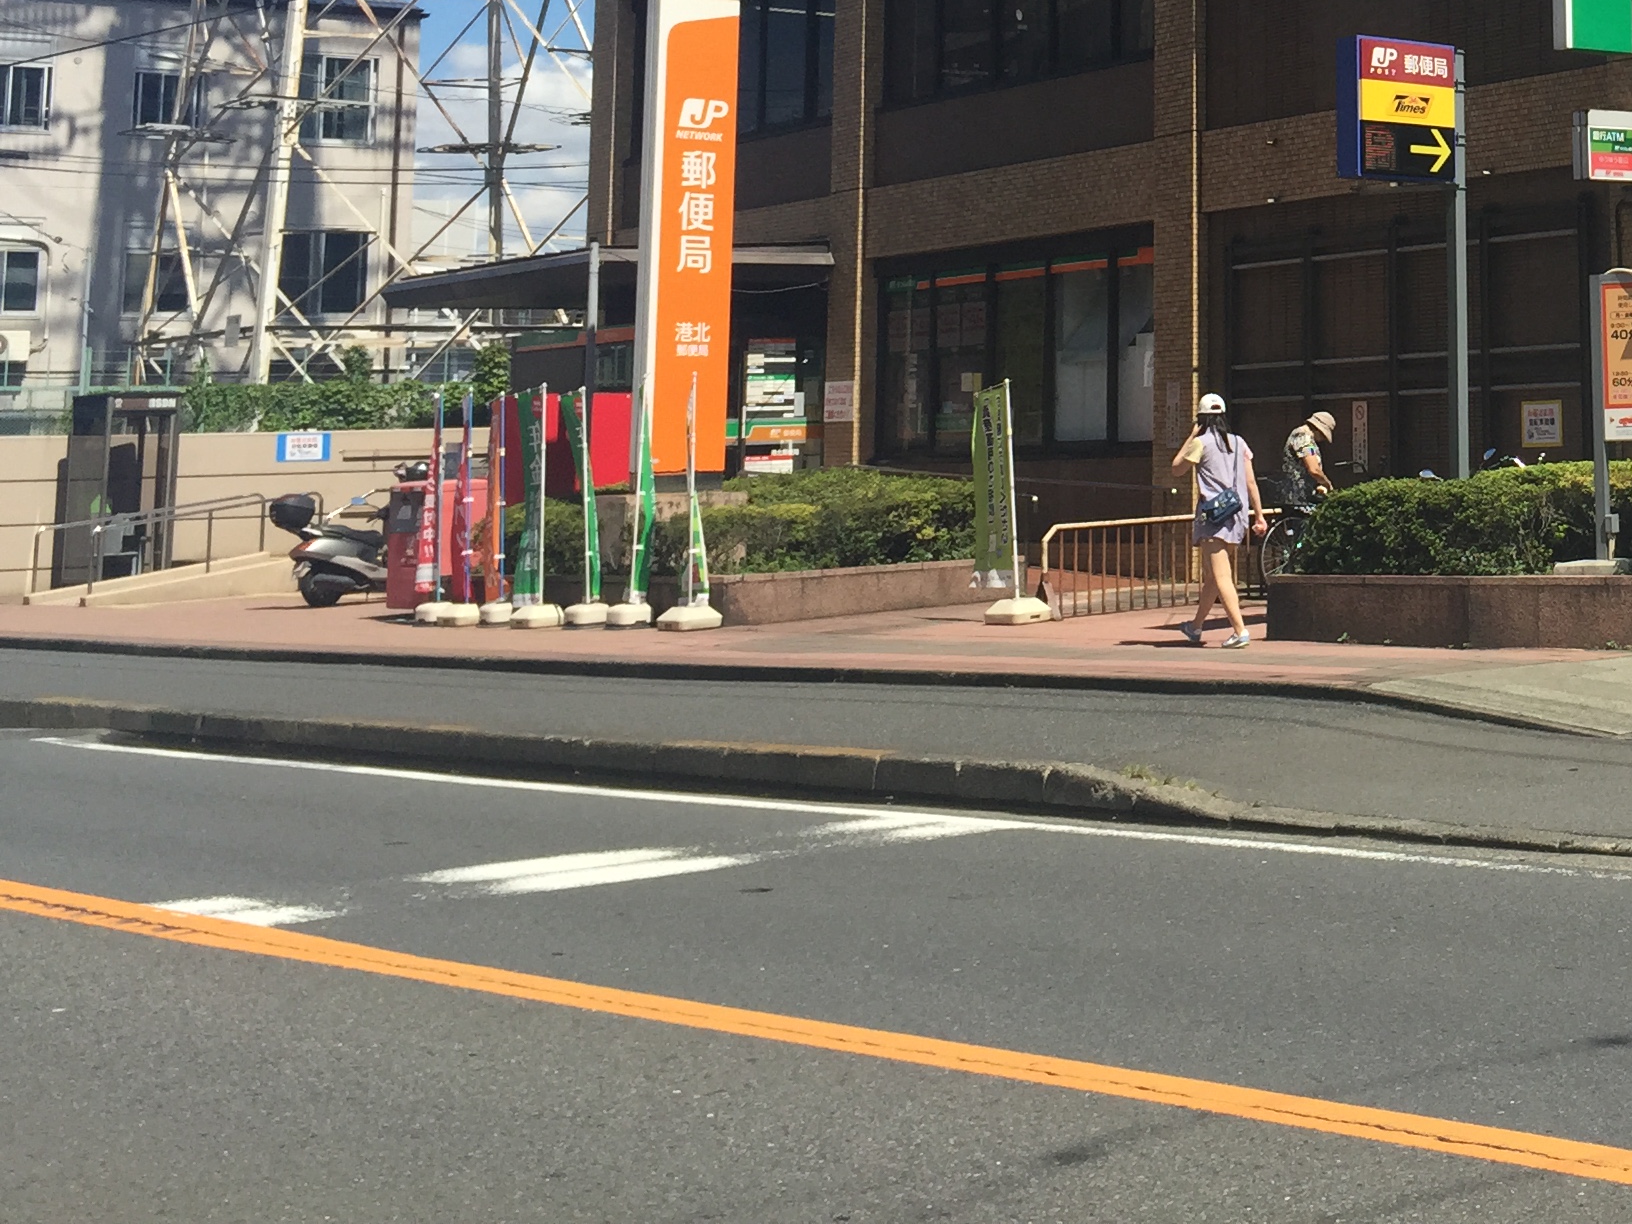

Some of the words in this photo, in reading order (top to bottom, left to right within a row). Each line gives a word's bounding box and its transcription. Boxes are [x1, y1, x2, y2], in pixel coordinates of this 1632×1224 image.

[1404, 54, 1448, 78] 郵便局
[1393, 94, 1430, 114] Times
[675, 130, 723, 142] NETWORK
[676, 149, 718, 274] 郵便局
[675, 322, 710, 342] 港北
